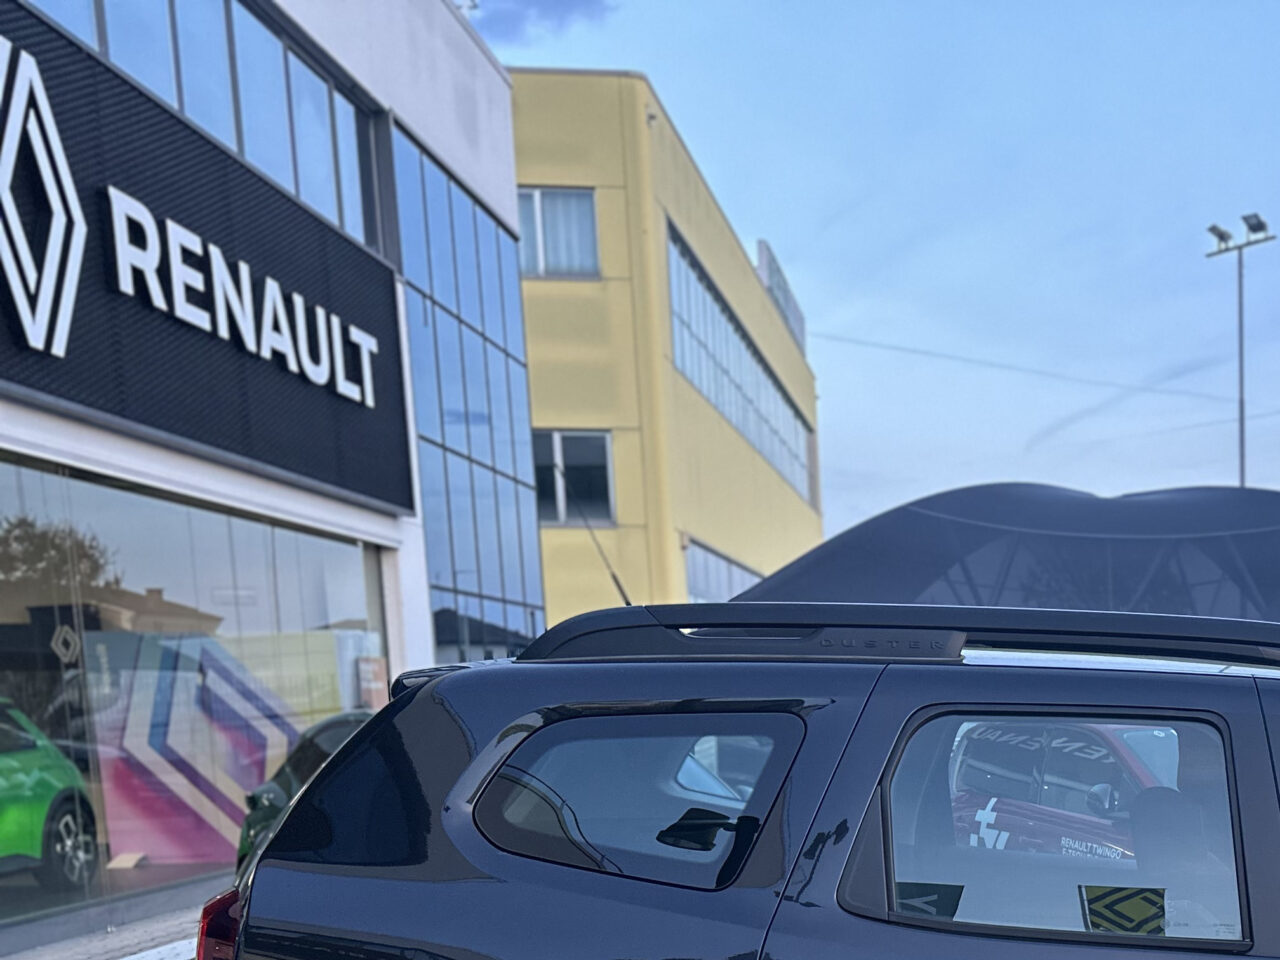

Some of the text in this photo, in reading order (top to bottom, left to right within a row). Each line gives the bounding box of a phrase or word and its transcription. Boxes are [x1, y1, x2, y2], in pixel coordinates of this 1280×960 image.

[107, 184, 378, 409] RENAULT
[819, 639, 945, 650] DUSTER
[1061, 836, 1092, 852] RENAULT
[1092, 844, 1122, 860] TWINGO
